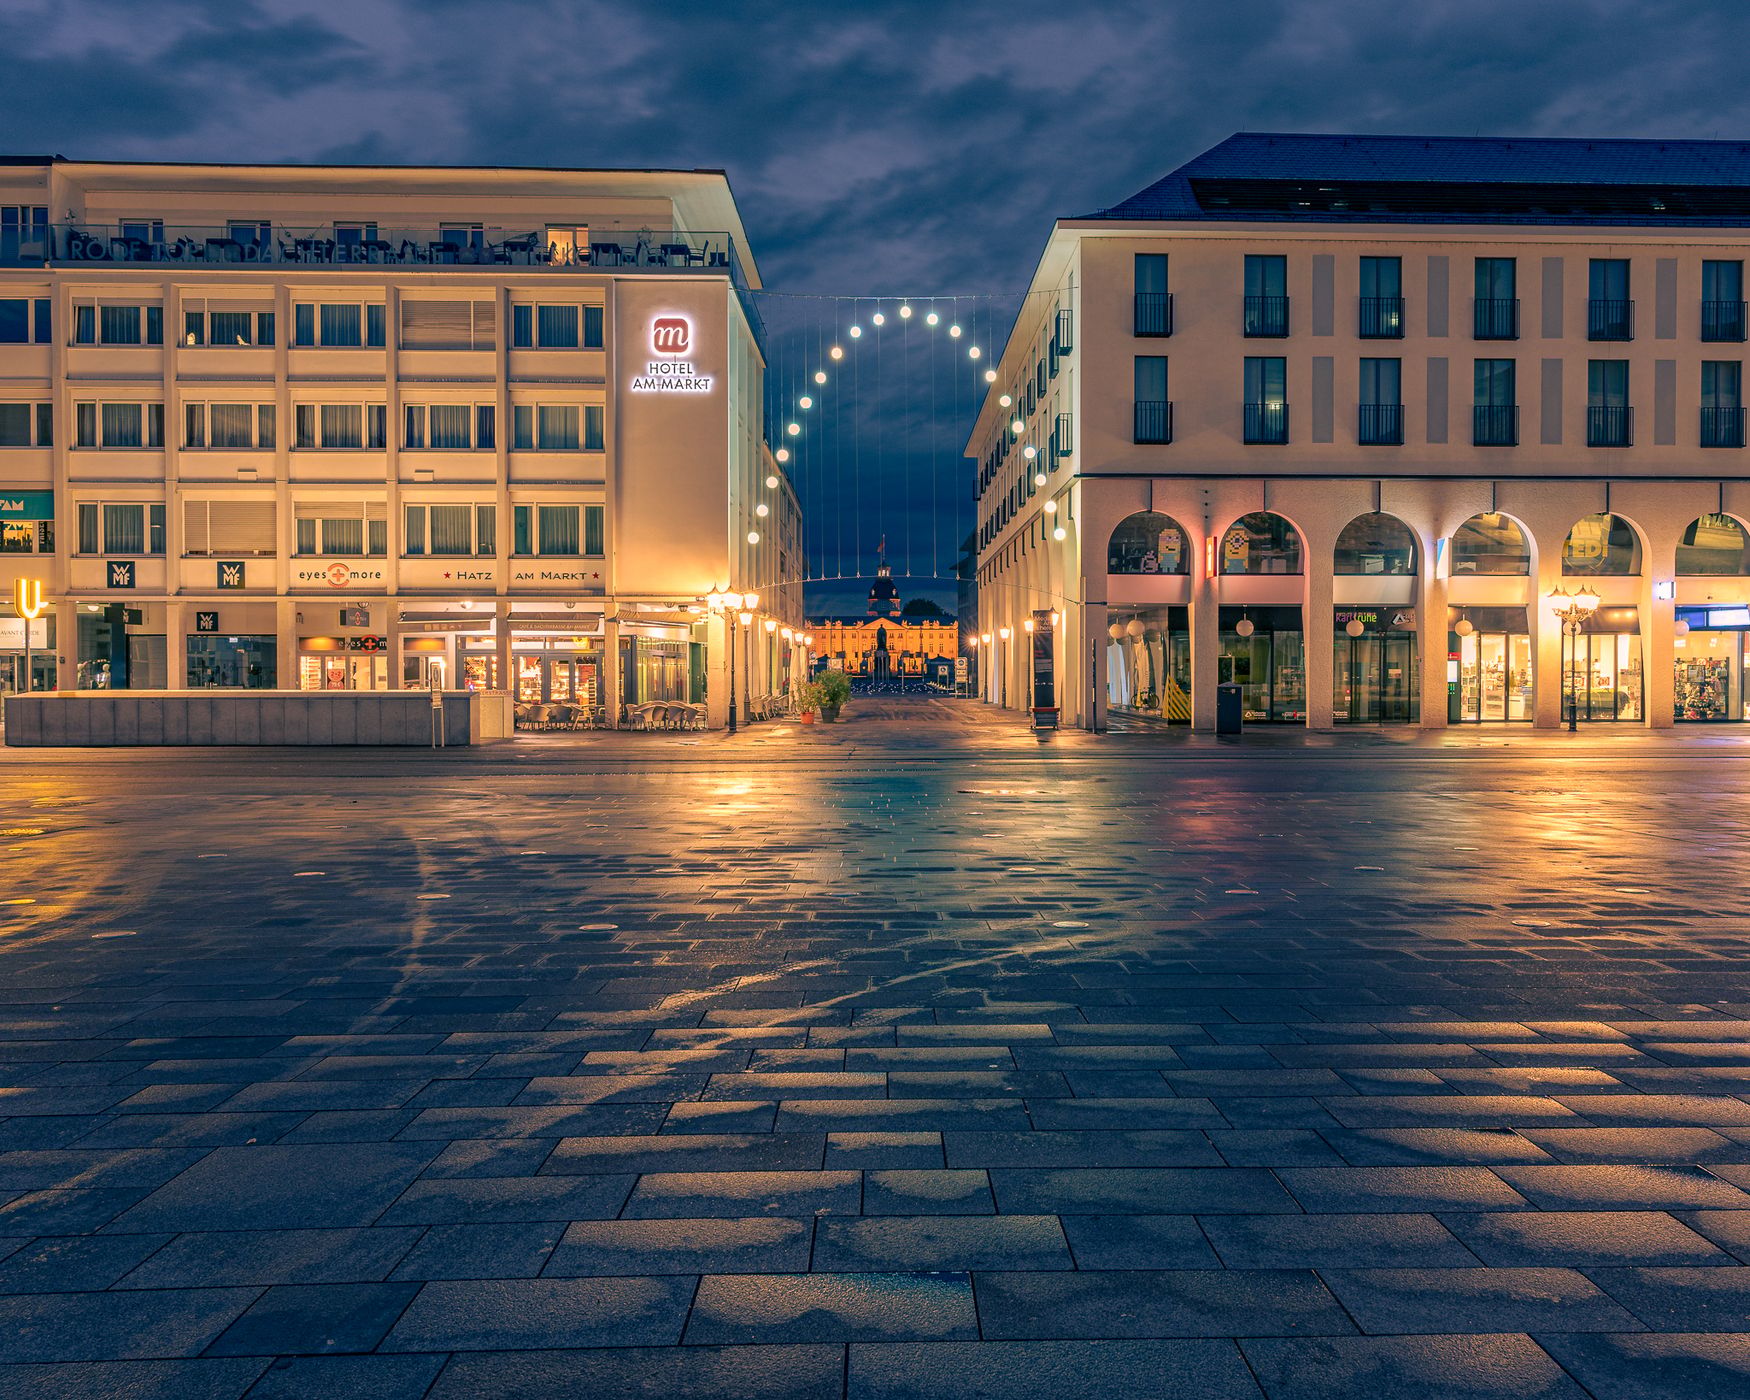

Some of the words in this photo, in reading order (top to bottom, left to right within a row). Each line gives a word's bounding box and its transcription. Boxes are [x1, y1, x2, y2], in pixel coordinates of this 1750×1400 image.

[71, 240, 141, 260] ROOF
[156, 243, 203, 262] TOP
[649, 363, 693, 374] HOTEL
[633, 379, 656, 389] AM
[661, 379, 710, 389] MARKT
[299, 571, 327, 580] eyes
[350, 571, 381, 579] more
[457, 571, 492, 580] HATZ
[541, 571, 588, 580] MARKT
[14, 578, 41, 619] U
[338, 640, 360, 649] eyes
